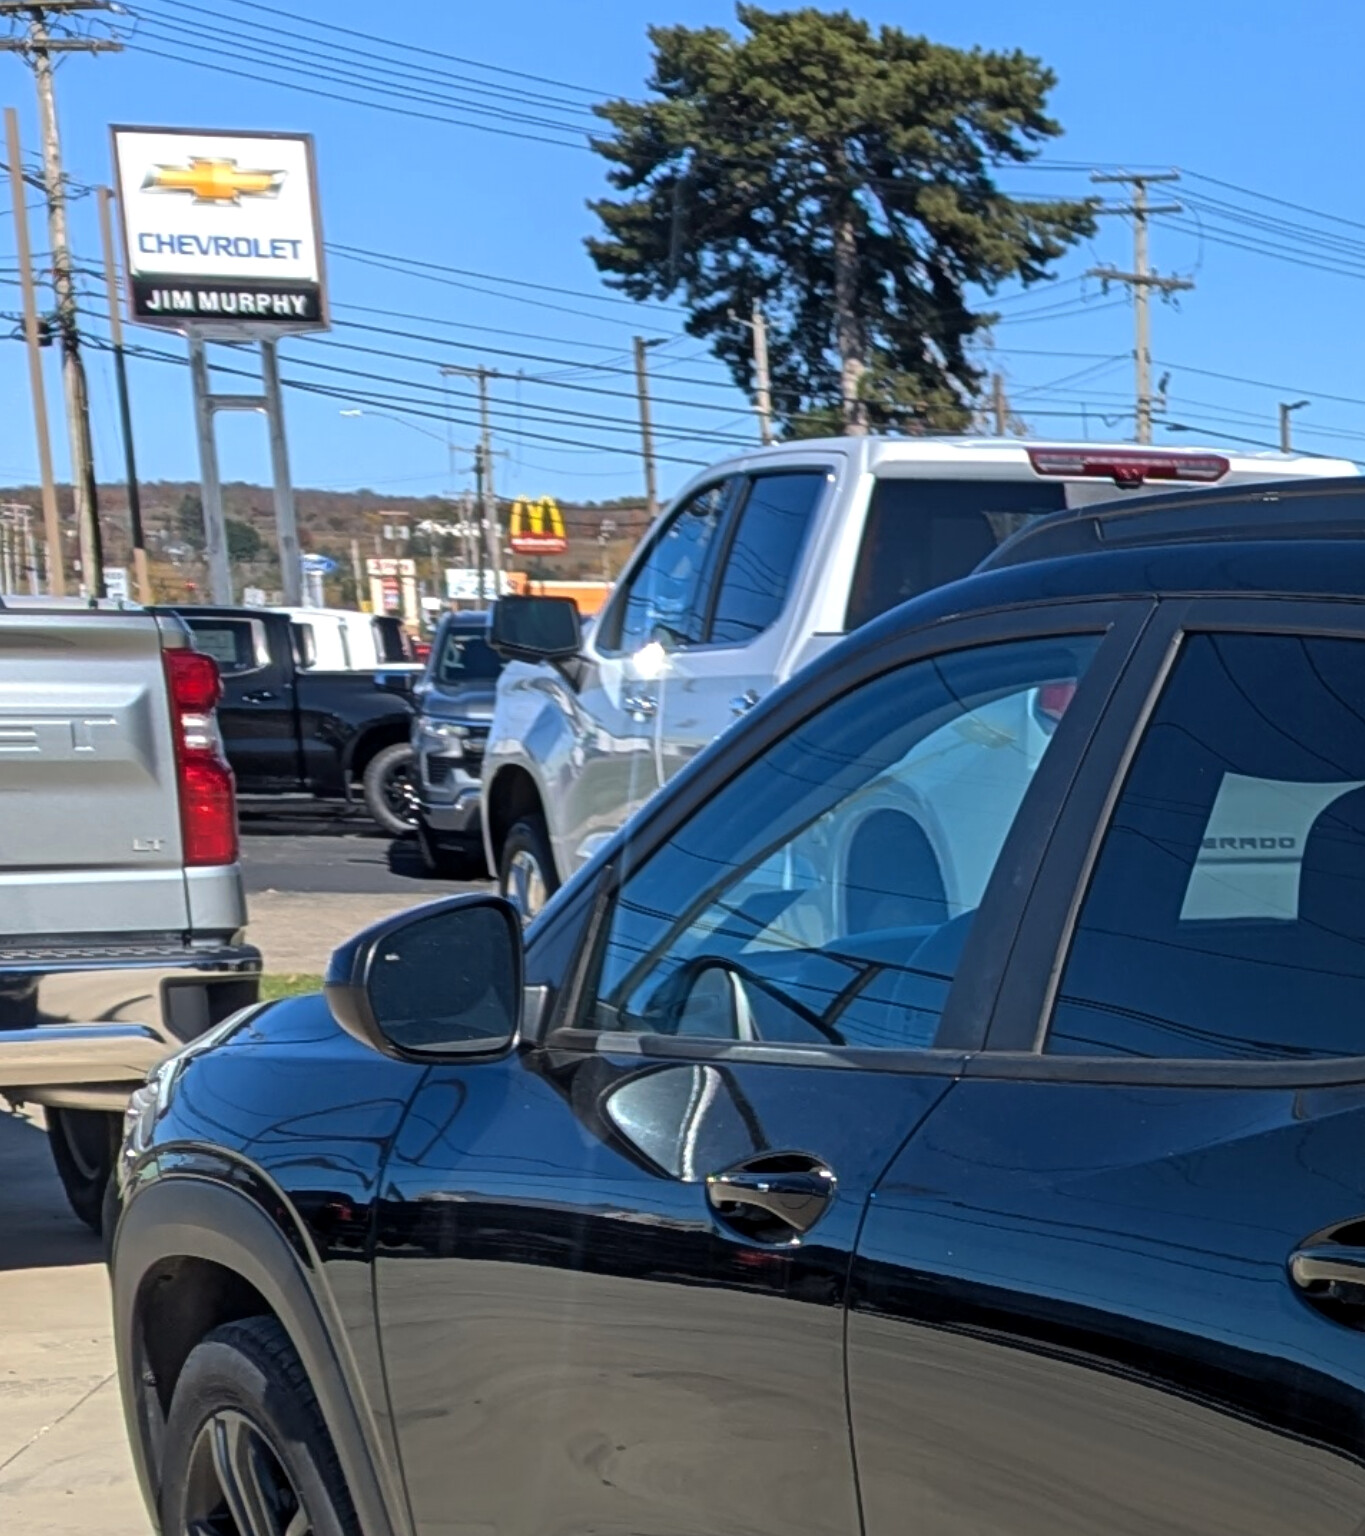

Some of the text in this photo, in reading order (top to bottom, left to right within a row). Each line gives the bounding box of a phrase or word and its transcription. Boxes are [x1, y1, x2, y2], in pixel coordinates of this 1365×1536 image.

[137, 232, 302, 260] CHEVROLET
[146, 289, 308, 316] JIM MURPHY
[132, 838, 165, 852] LT
